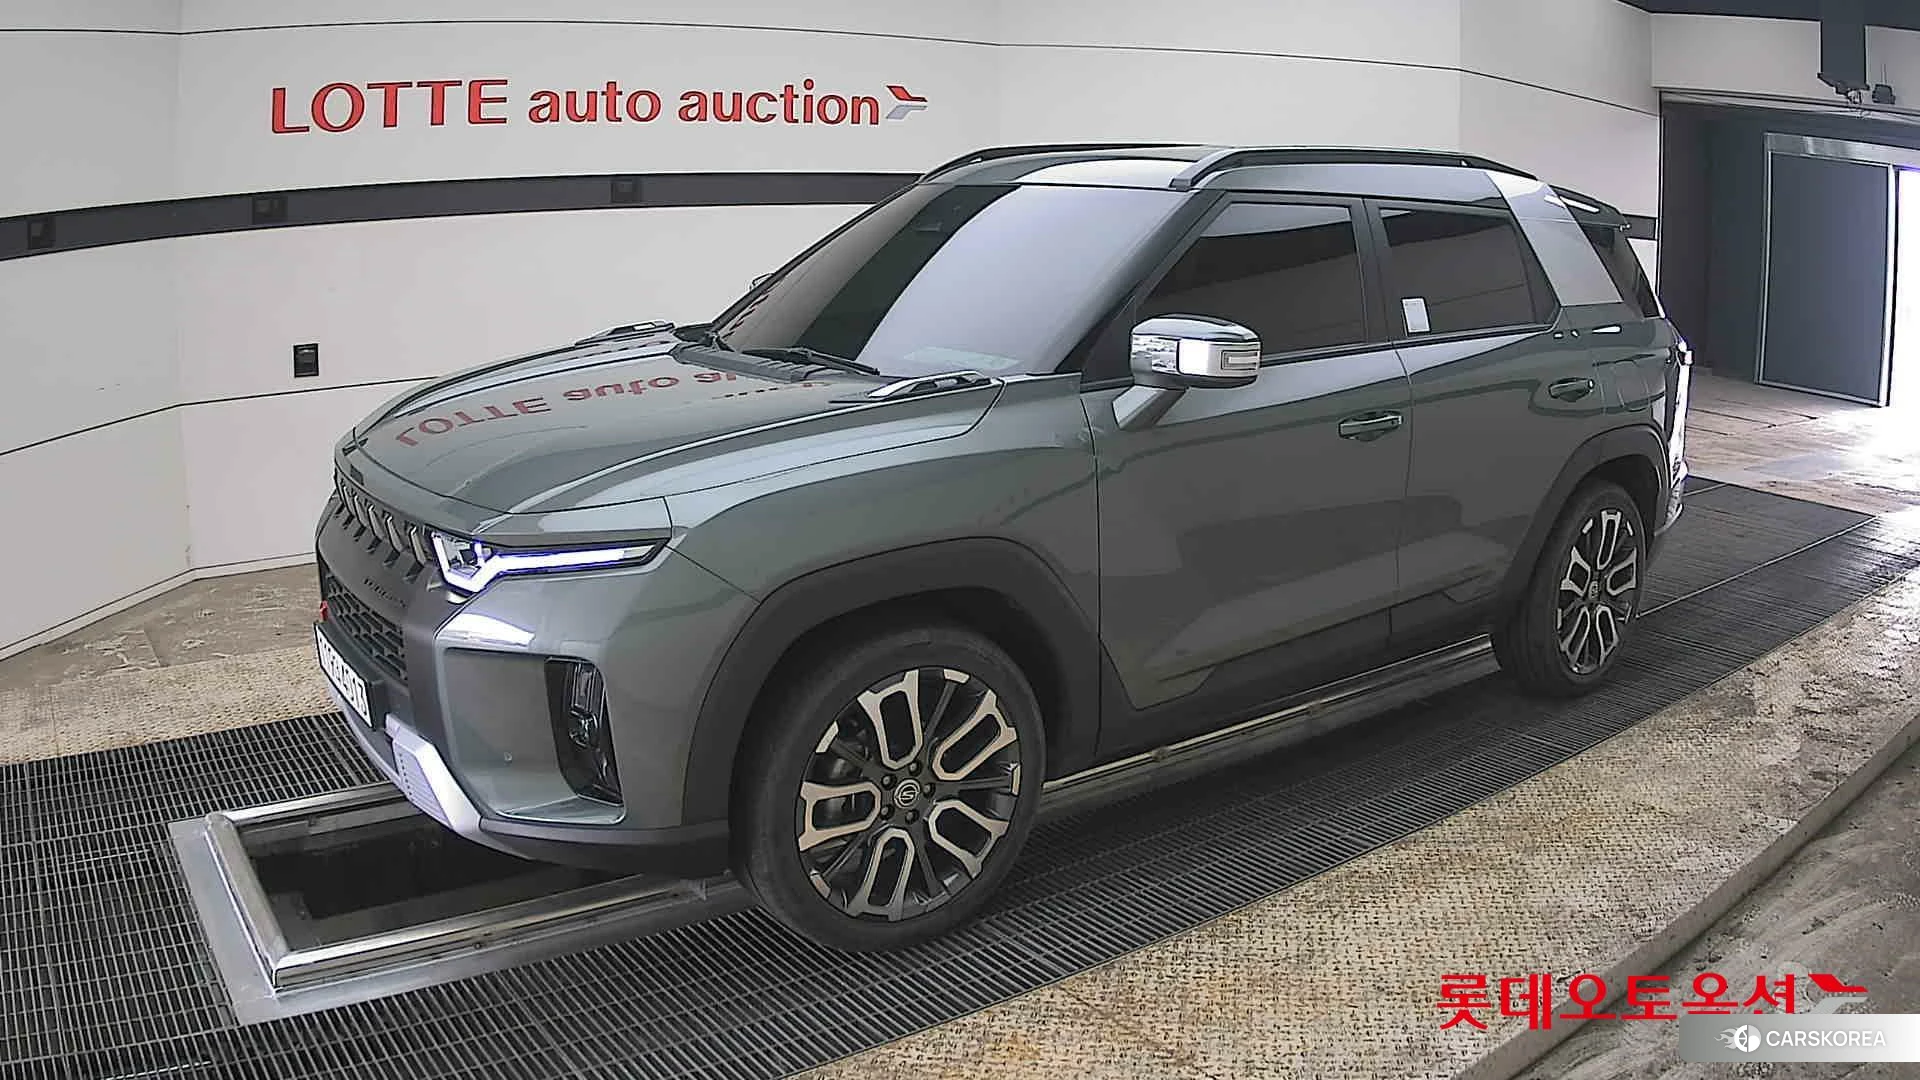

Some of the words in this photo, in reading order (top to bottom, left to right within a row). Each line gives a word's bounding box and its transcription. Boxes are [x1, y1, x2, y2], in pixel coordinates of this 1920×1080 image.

[271, 79, 508, 134] LOTTE
[528, 79, 662, 125] auto
[677, 78, 880, 126] auction
